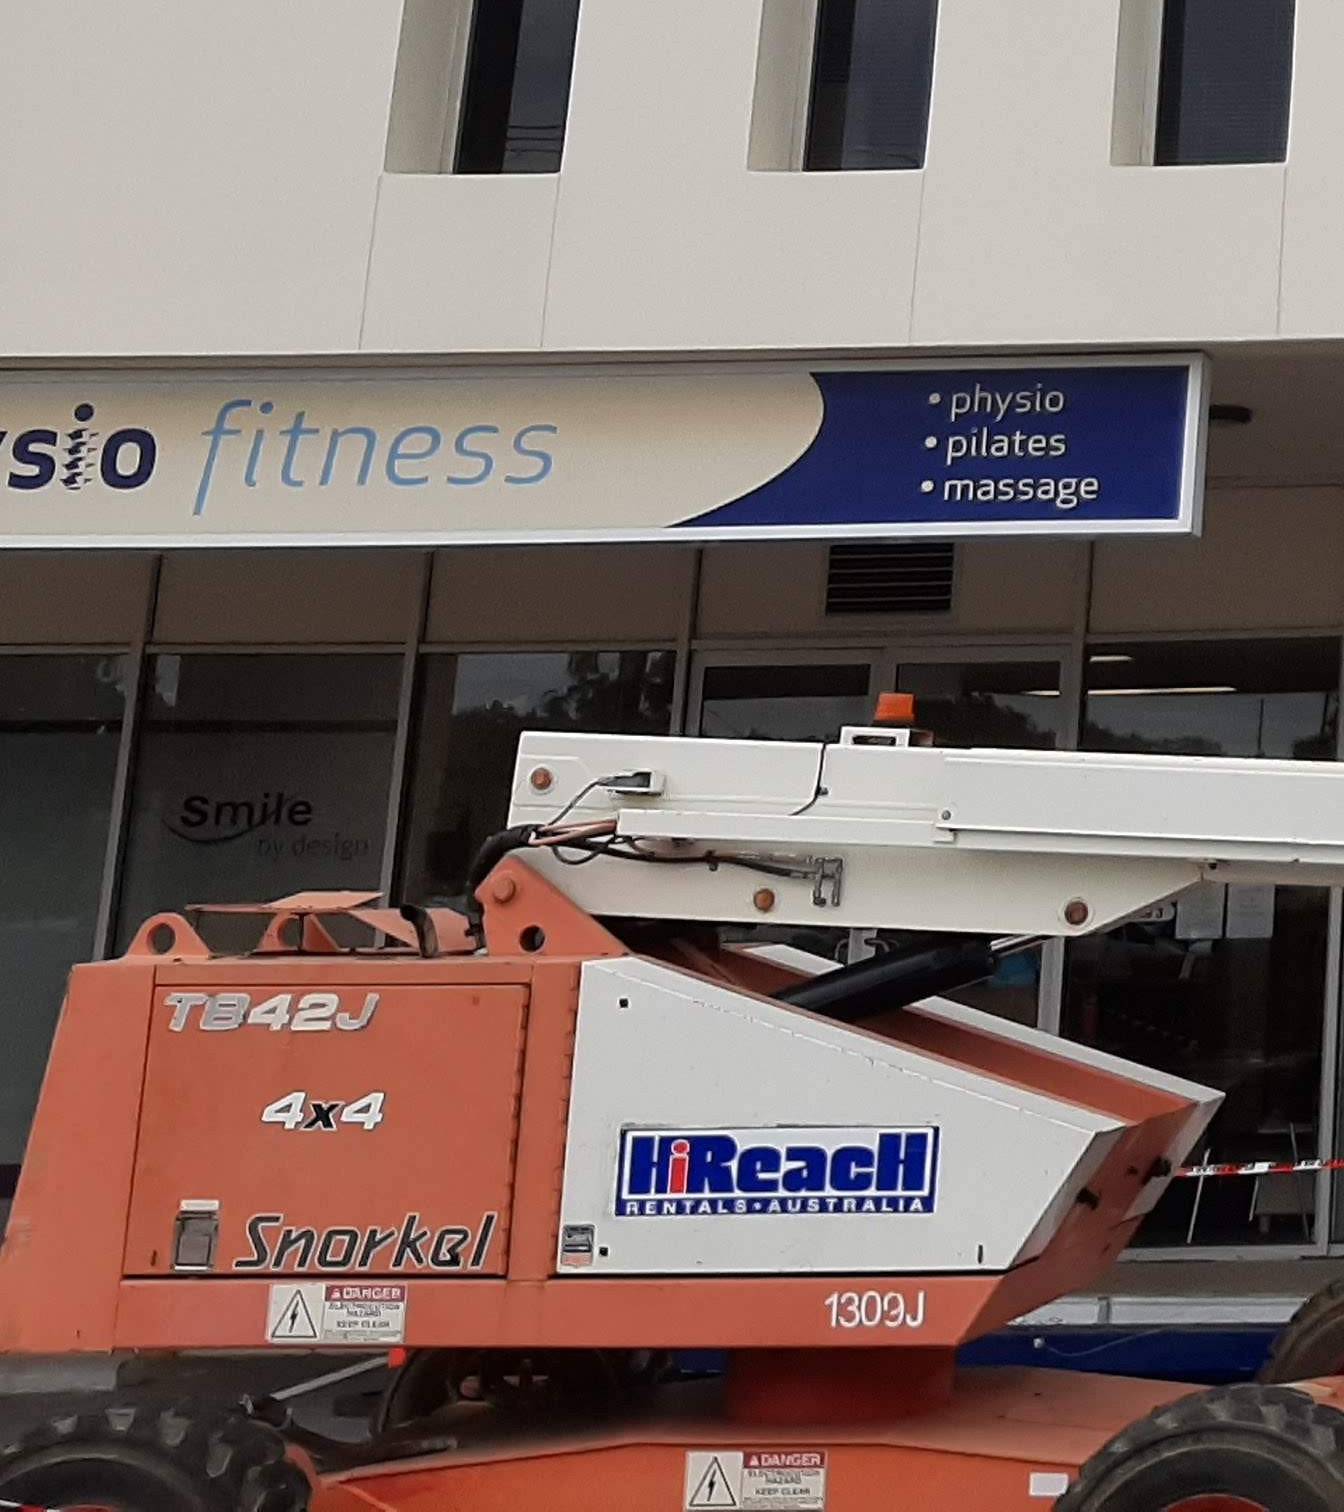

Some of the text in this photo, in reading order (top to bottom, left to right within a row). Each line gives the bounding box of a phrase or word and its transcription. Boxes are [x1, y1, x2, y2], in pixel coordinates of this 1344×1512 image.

[950, 383, 1066, 423] physio
[0, 399, 559, 516] sio fitness
[945, 426, 1067, 465] pilates
[943, 472, 1100, 509] massage
[180, 792, 314, 828] Smile
[291, 831, 370, 861] design
[163, 991, 381, 1033] TB42J
[260, 1089, 386, 1132] 4x4
[625, 1197, 925, 1215] RENTALS AUSTRALIA
[232, 1210, 499, 1273] Snorkel
[824, 1289, 926, 1329] 1309J
[760, 1453, 821, 1467] DANGER
